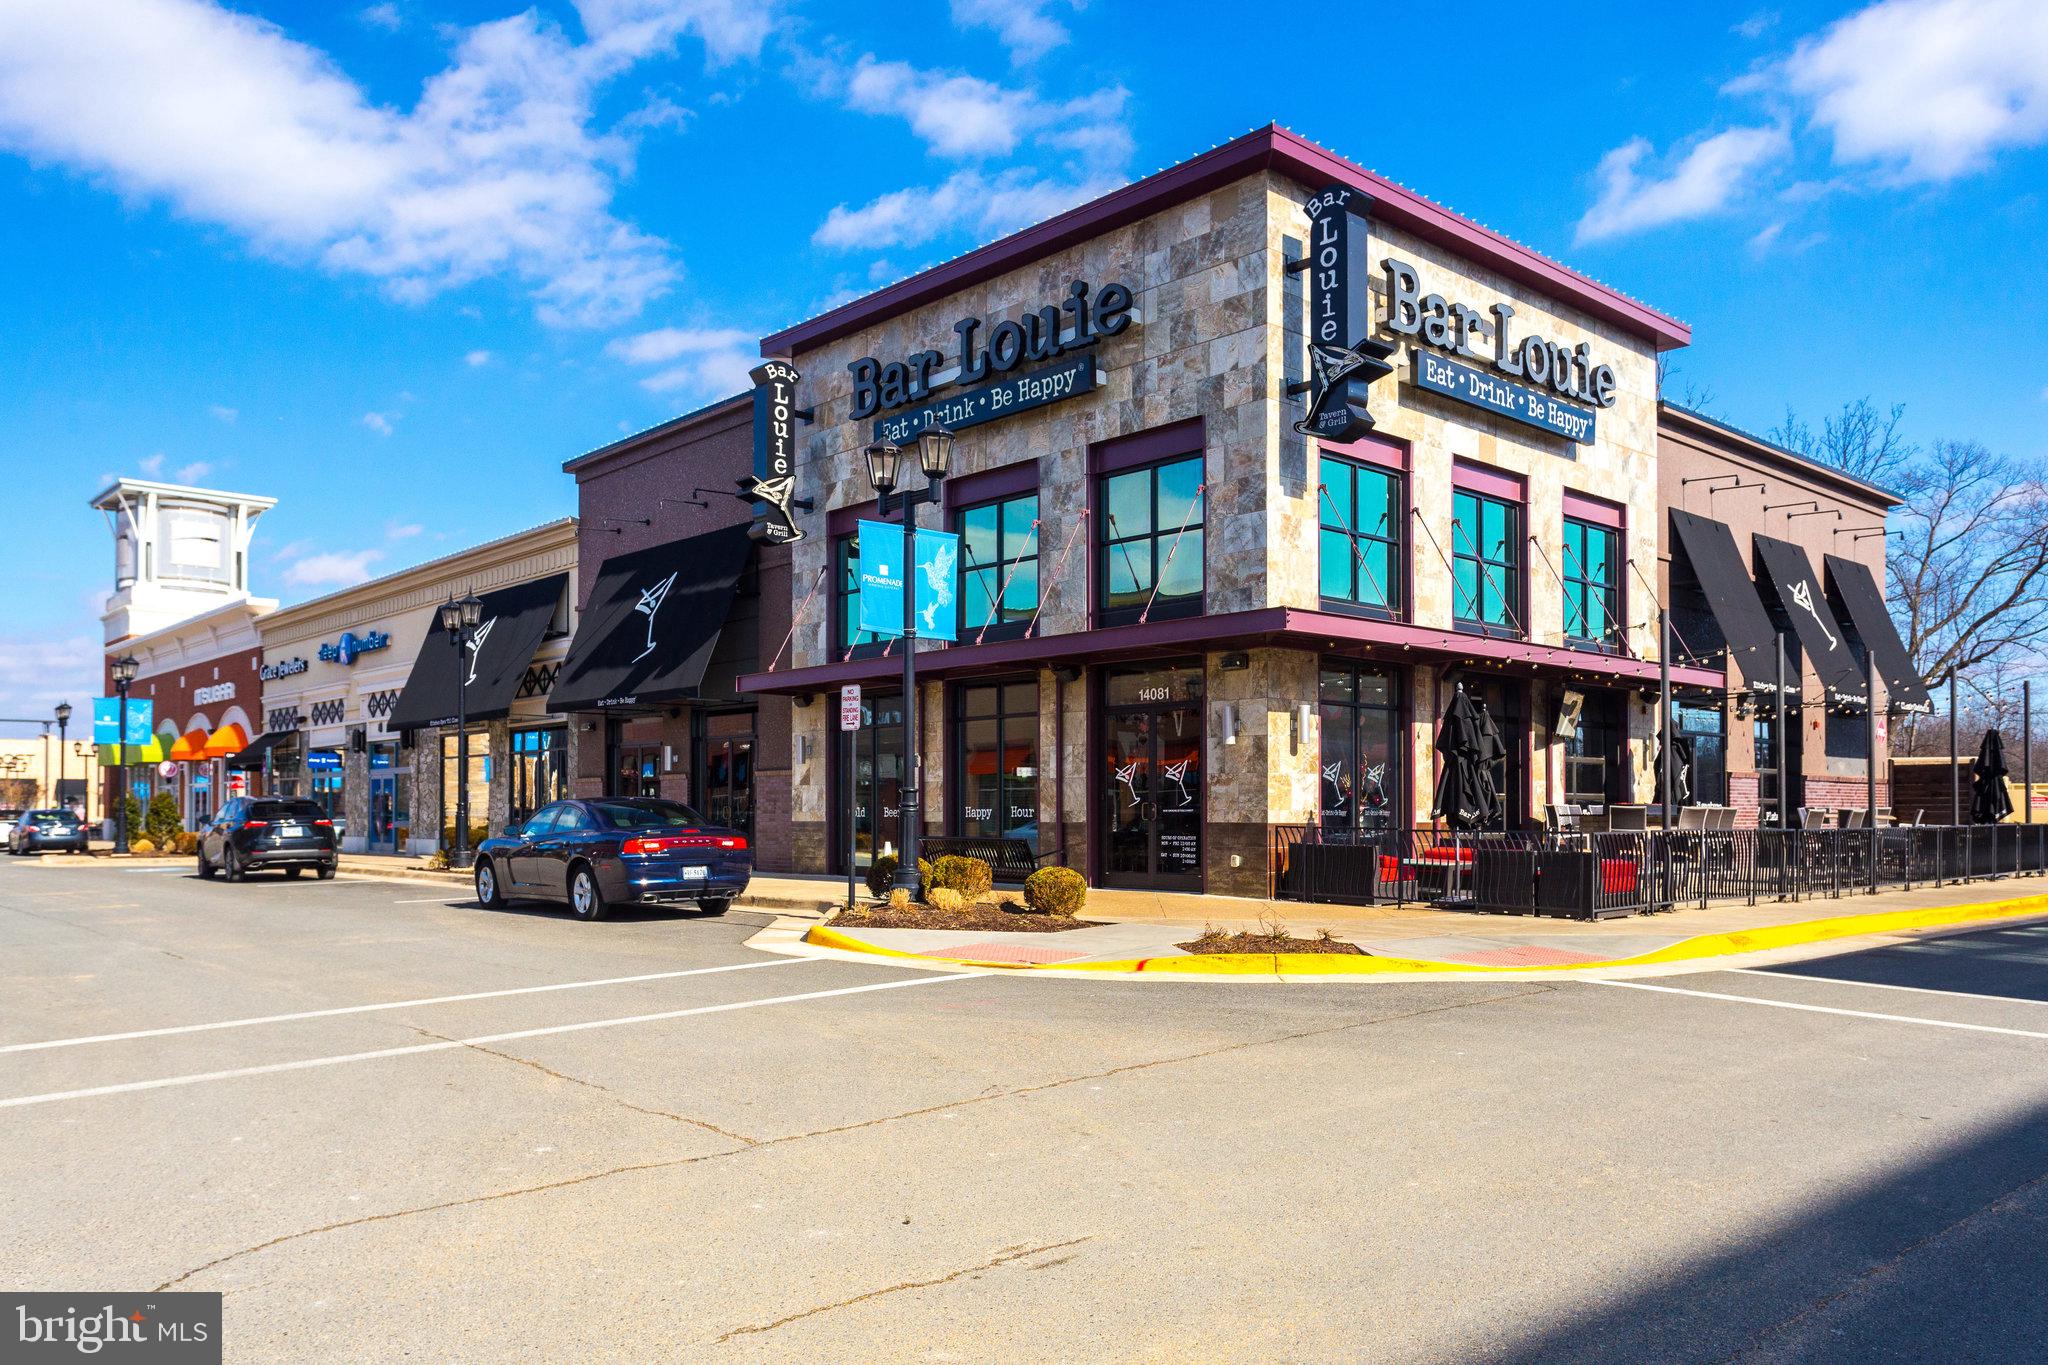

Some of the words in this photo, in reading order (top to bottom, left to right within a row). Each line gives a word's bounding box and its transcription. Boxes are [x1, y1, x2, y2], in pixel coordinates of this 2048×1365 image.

[1306, 190, 1350, 218] Bar
[1319, 217, 1339, 341] Louie
[1380, 257, 1483, 358] Bar
[1489, 303, 1617, 408] Louie
[848, 350, 944, 421] Bar
[953, 279, 1134, 386] Louie
[764, 363, 799, 383] Bar
[1426, 359, 1455, 389] Eat
[1469, 373, 1516, 410] Drink
[1527, 394, 1545, 420] Be
[883, 418, 909, 441] Eat
[991, 387, 1013, 411] Be
[1319, 407, 1347, 421] Tavern
[1327, 416, 1347, 427] Grill
[773, 383, 789, 475] Louie
[767, 522, 788, 532] Tavern
[773, 529, 788, 538] Grill
[862, 573, 904, 588] PROMENADE
[1138, 687, 1170, 701] 14081
[965, 807, 992, 819] Happy
[1011, 806, 1035, 818] Hour
[1460, 808, 1471, 819] Bar
